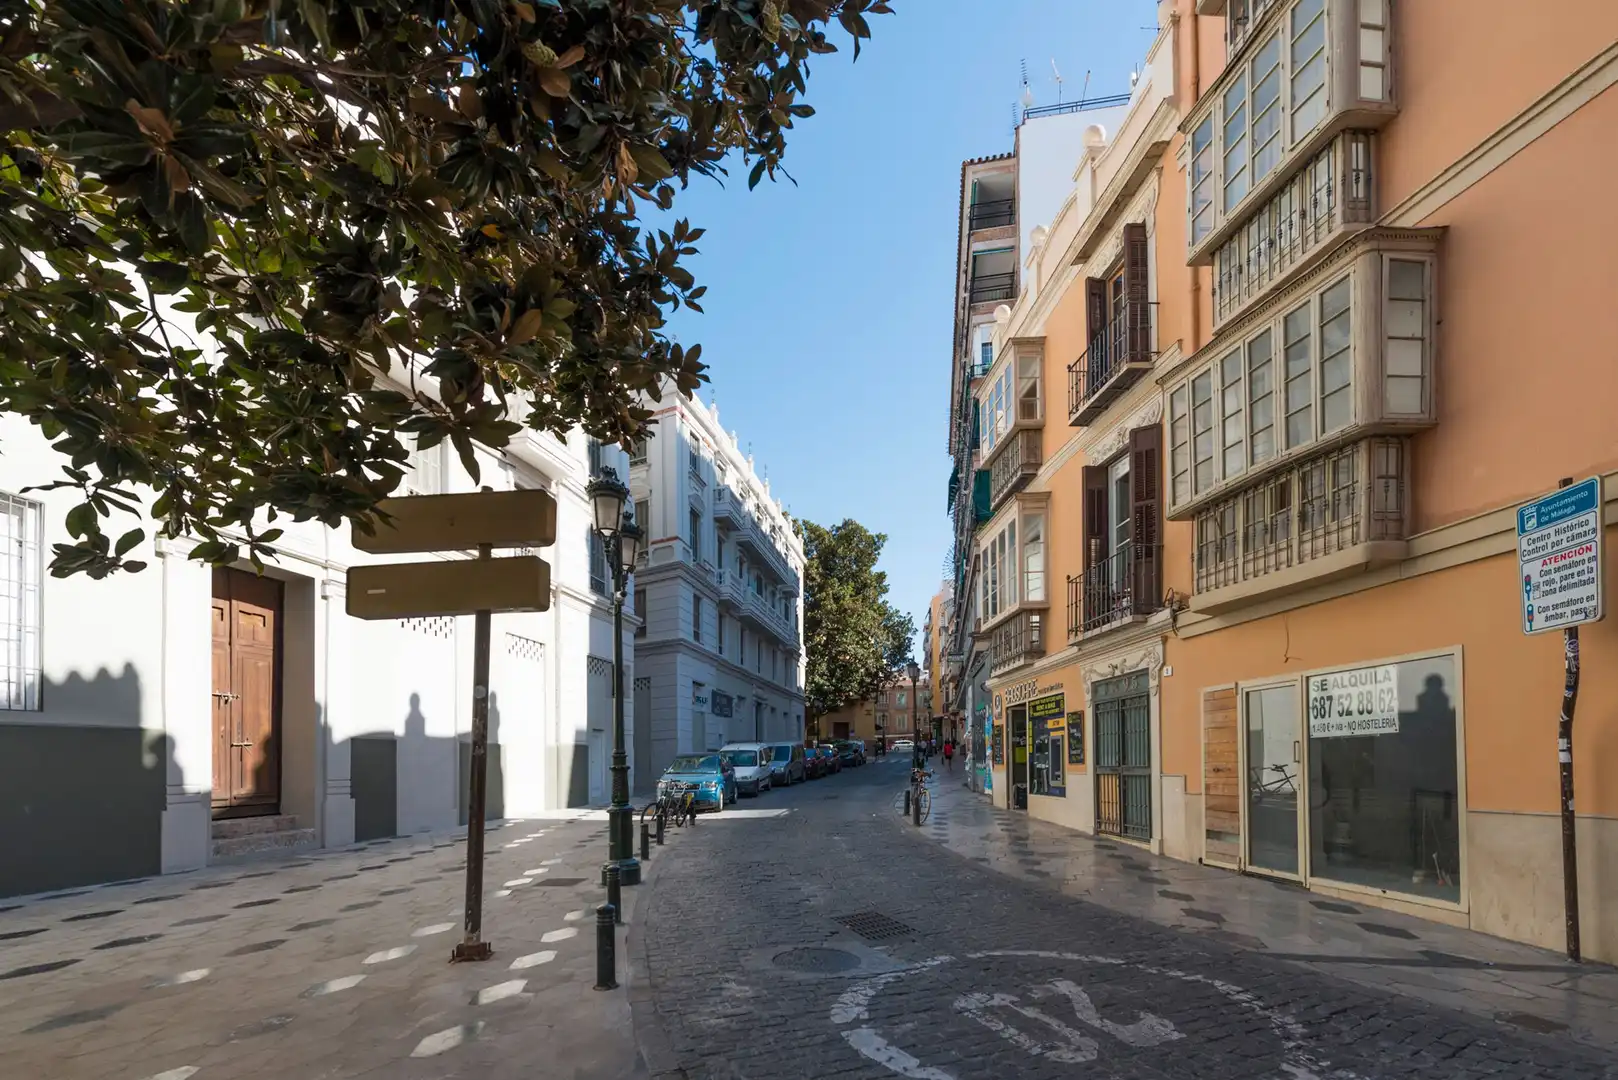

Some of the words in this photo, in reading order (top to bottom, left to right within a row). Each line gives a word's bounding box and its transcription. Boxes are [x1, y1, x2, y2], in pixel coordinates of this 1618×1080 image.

[1540, 490, 1589, 514] Ayuntamiento
[1540, 514, 1549, 523] de
[1522, 542, 1549, 558] Control
[1551, 537, 1564, 550] por
[1566, 527, 1596, 543] cámara
[1527, 532, 1551, 546] Centro
[1555, 518, 1589, 537] Histórico
[1540, 568, 1552, 578] Con
[1553, 558, 1586, 575] semáforo
[1588, 555, 1596, 565] en
[1560, 570, 1575, 583] pare
[1577, 569, 1586, 578] en
[1587, 566, 1594, 575] la
[1542, 586, 1557, 598] zona
[1559, 577, 1595, 594] delimitada
[1537, 604, 1551, 614] Con
[1552, 596, 1585, 612] semáforo
[1586, 593, 1595, 602] en
[1312, 679, 1328, 692] SE
[1332, 669, 1392, 690] ALQUILA
[1312, 695, 1334, 720] 687
[1337, 692, 1353, 717] 52
[1357, 690, 1374, 716] 88
[1378, 687, 1395, 713] 62
[1347, 720, 1356, 731] NO
